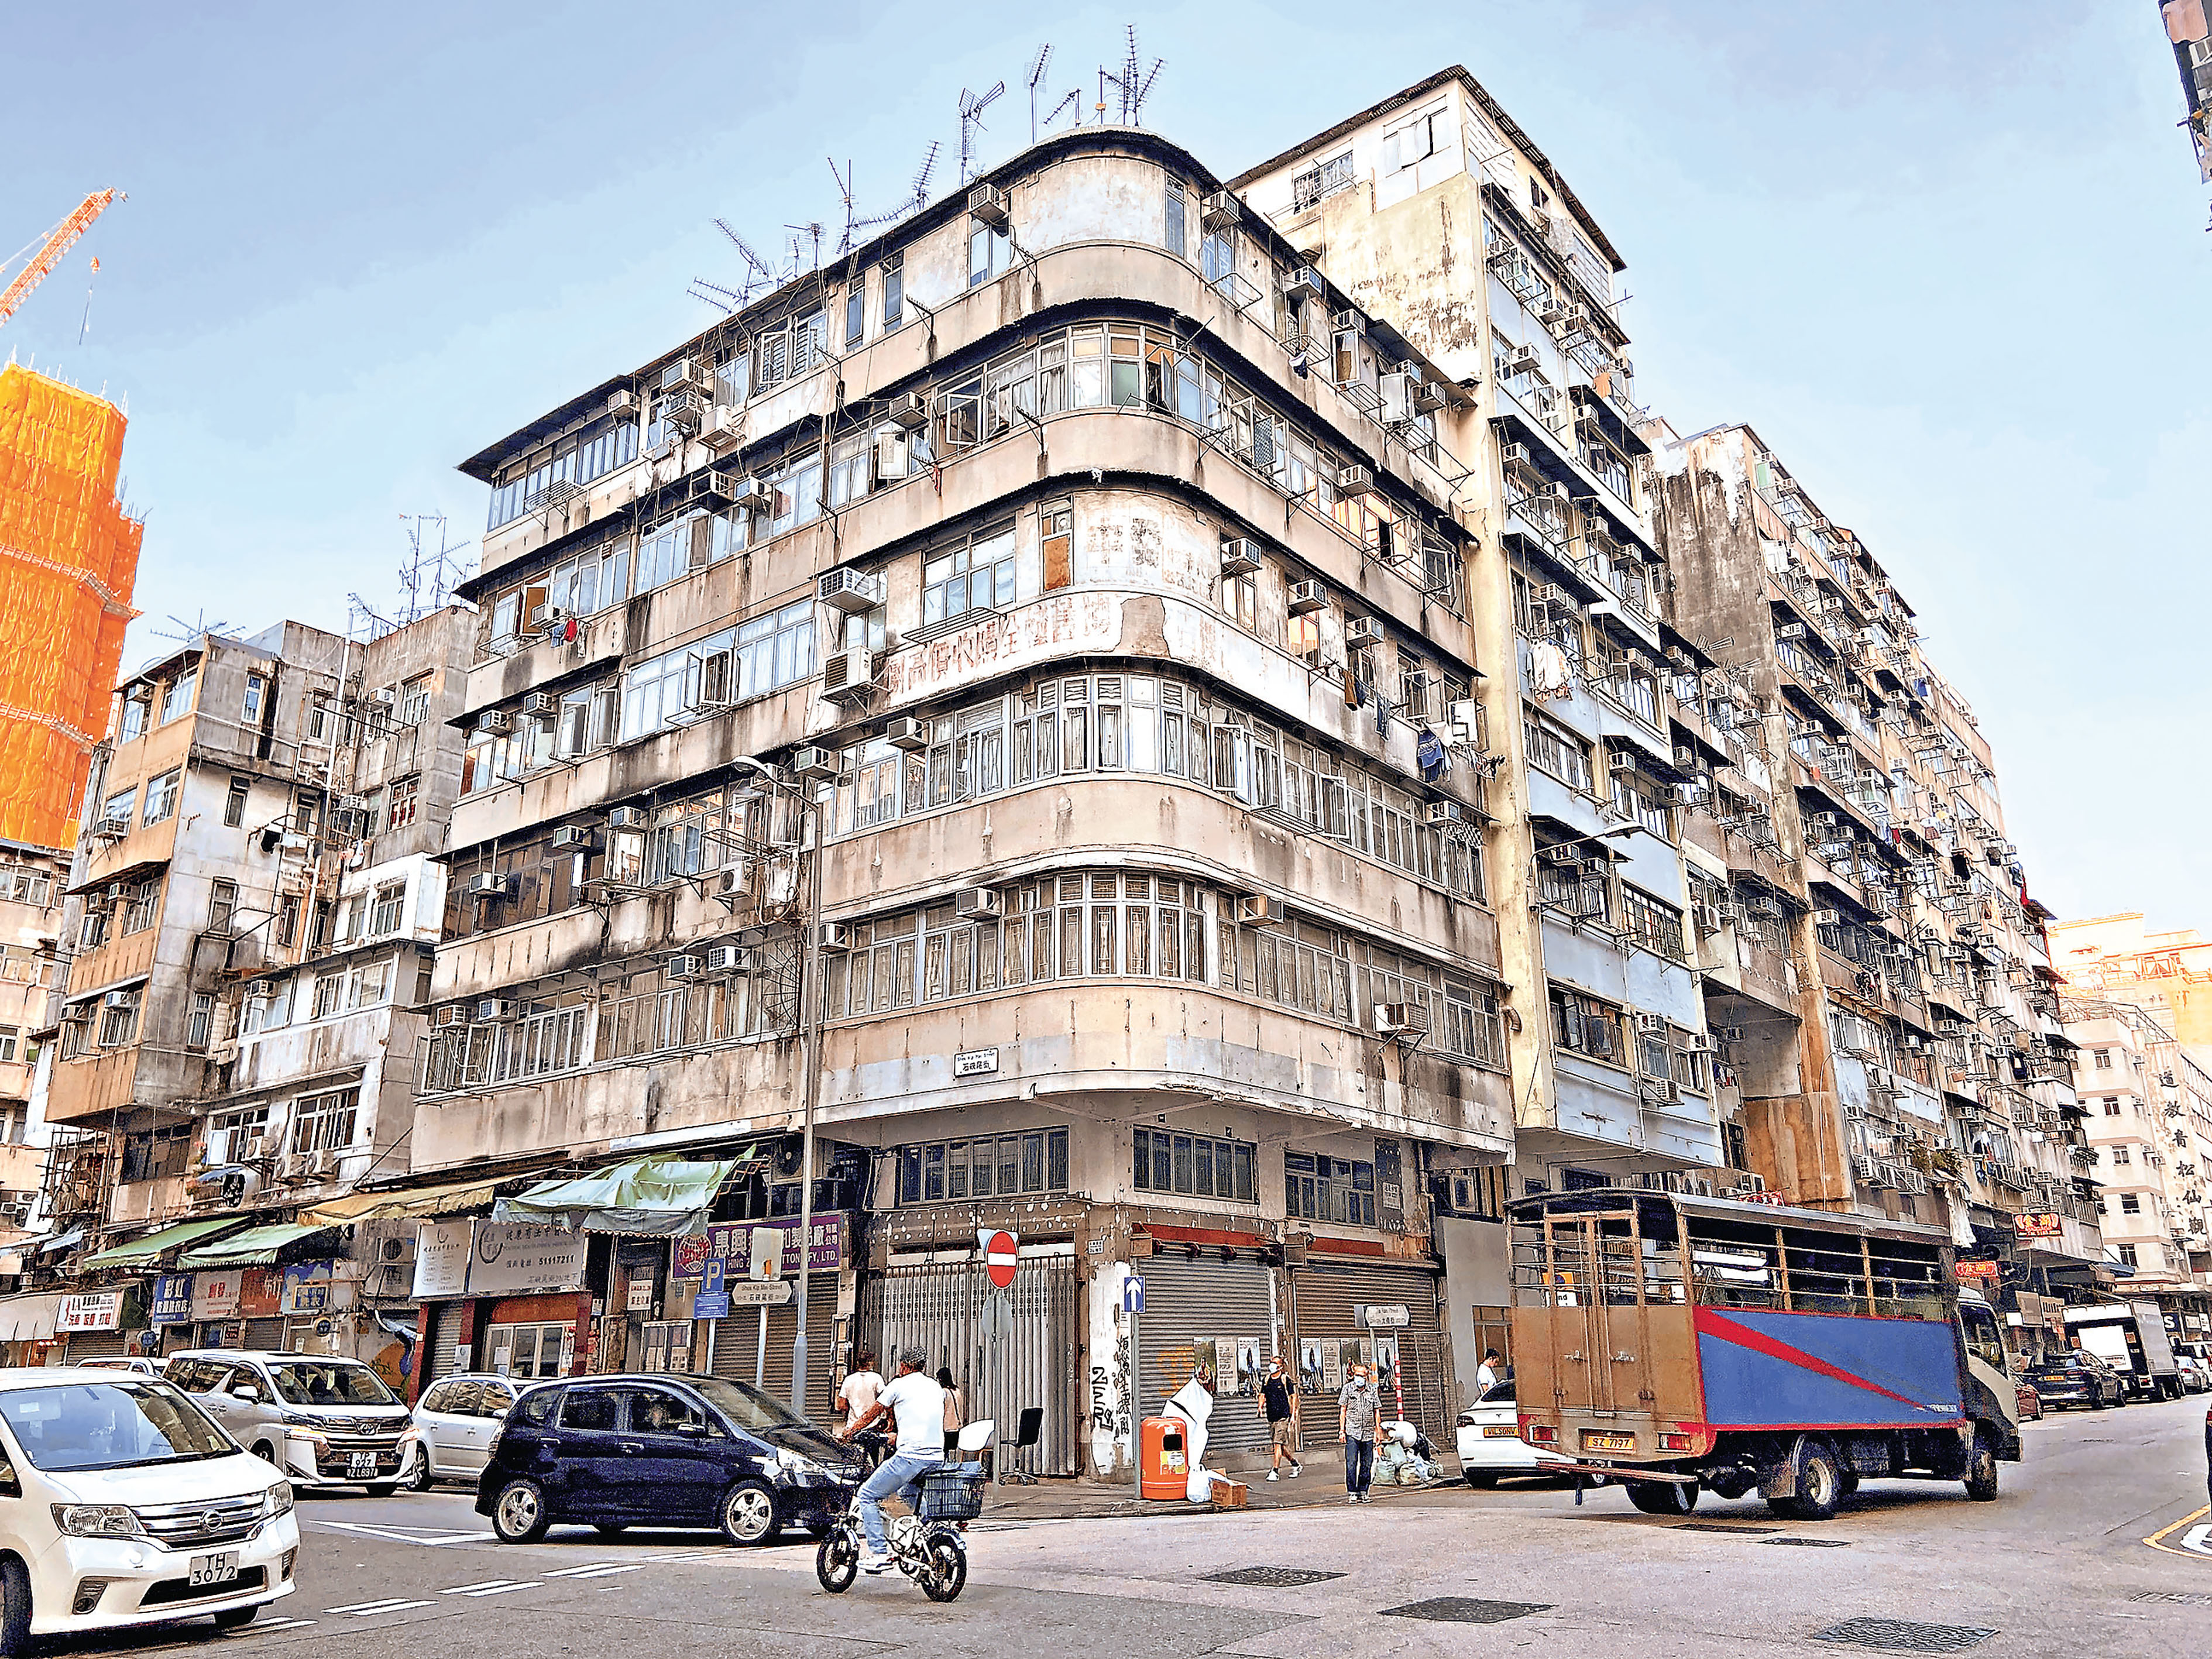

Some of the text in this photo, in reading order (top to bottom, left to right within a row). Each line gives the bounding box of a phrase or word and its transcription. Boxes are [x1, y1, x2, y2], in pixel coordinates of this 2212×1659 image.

[539, 1255, 574, 1265] 51117211
[706, 1262, 720, 1289] P
[1592, 1437, 1605, 1447] SZ
[205, 1552, 226, 1569] TH
[192, 1565, 235, 1584] 3072
